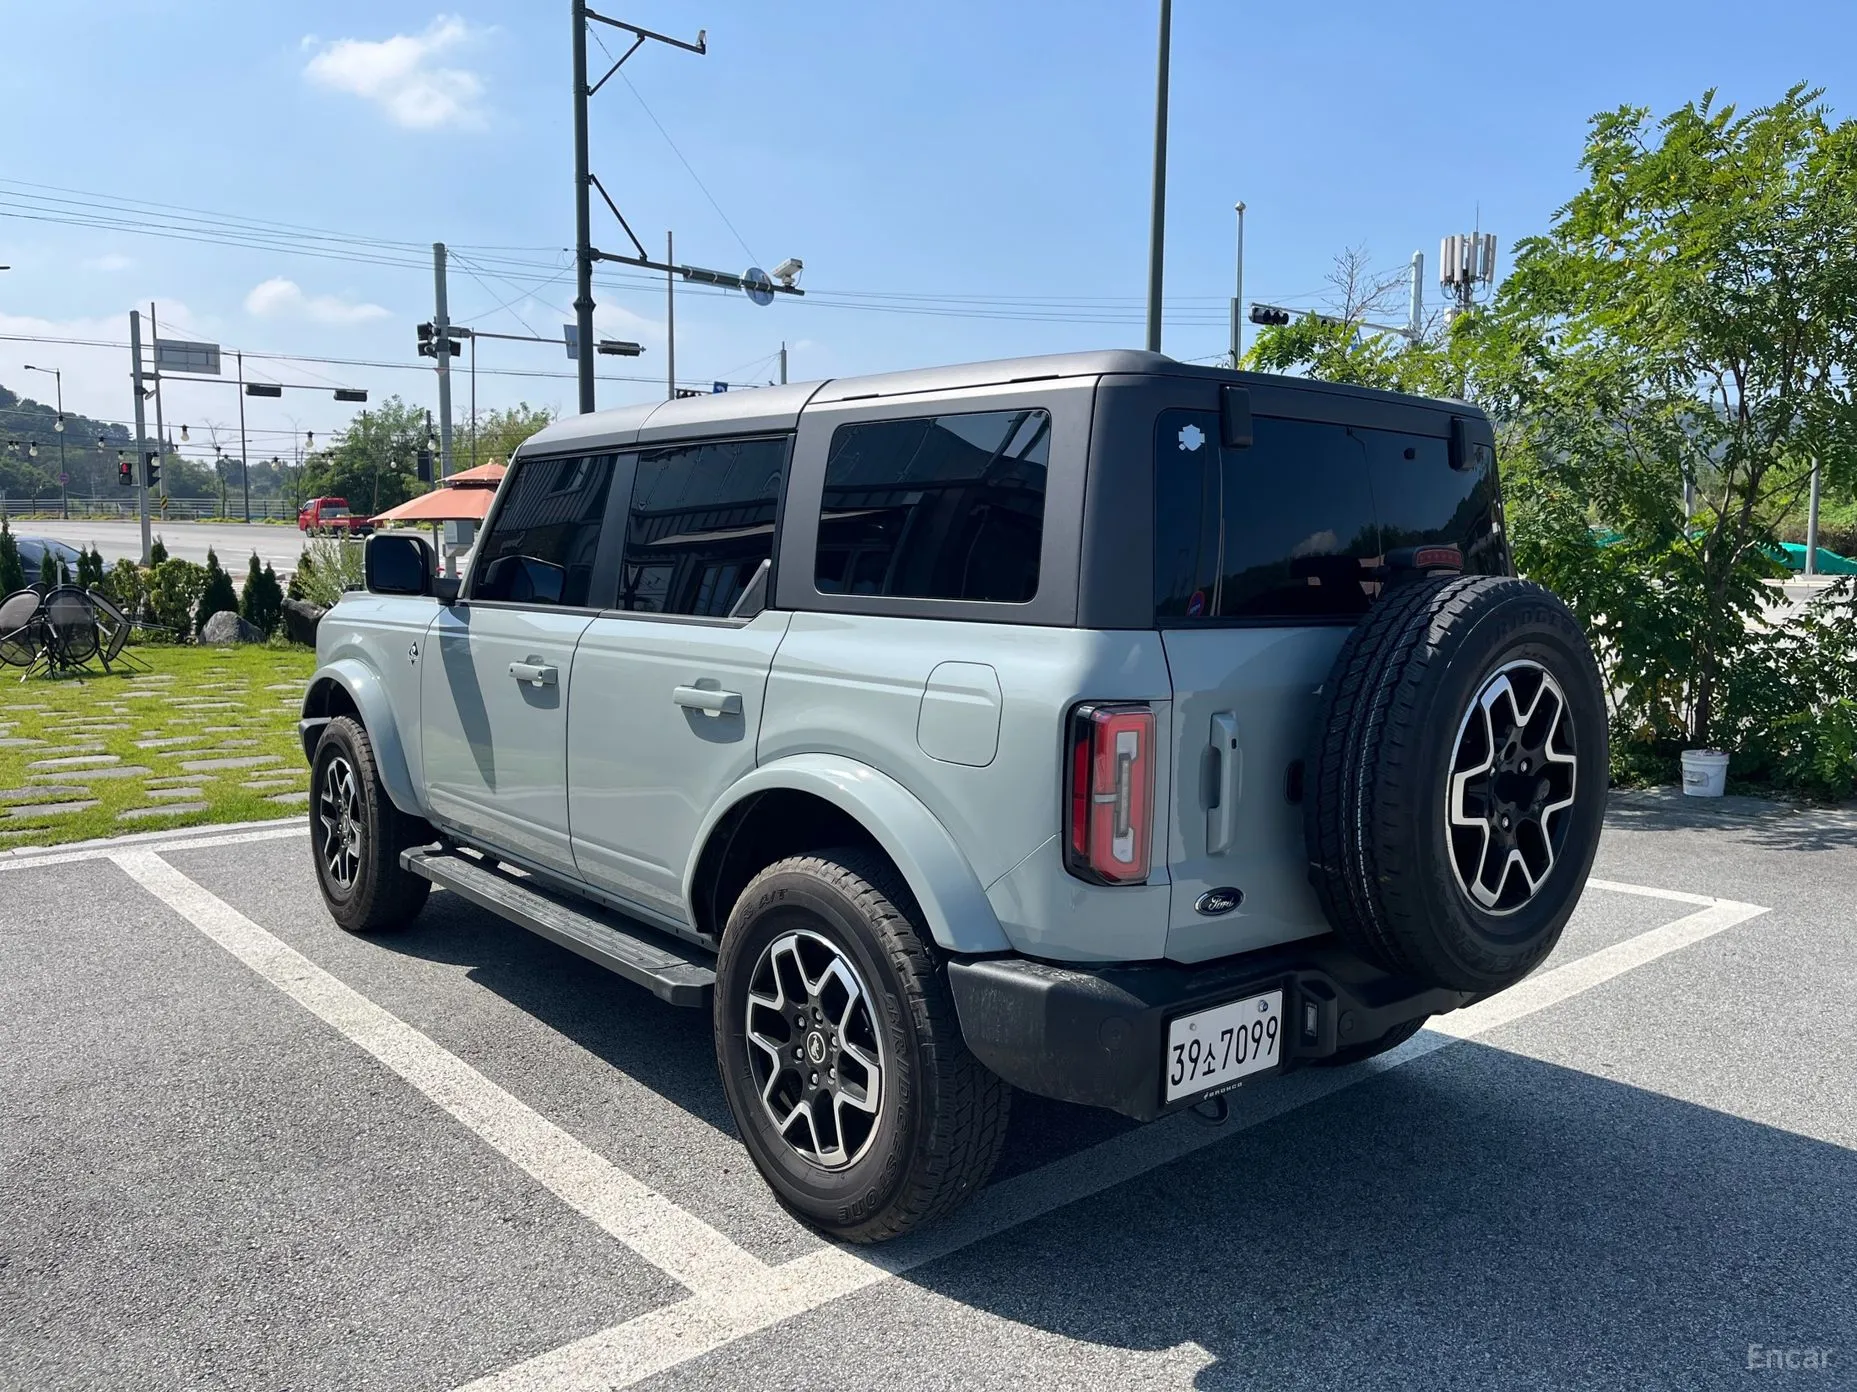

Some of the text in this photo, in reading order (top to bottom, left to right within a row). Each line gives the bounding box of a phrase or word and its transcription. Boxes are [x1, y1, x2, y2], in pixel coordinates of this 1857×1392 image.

[1209, 895, 1234, 911] Ford
[1171, 1015, 1278, 1086] 39소7099
[837, 991, 916, 1225] BRIDGESTONE
